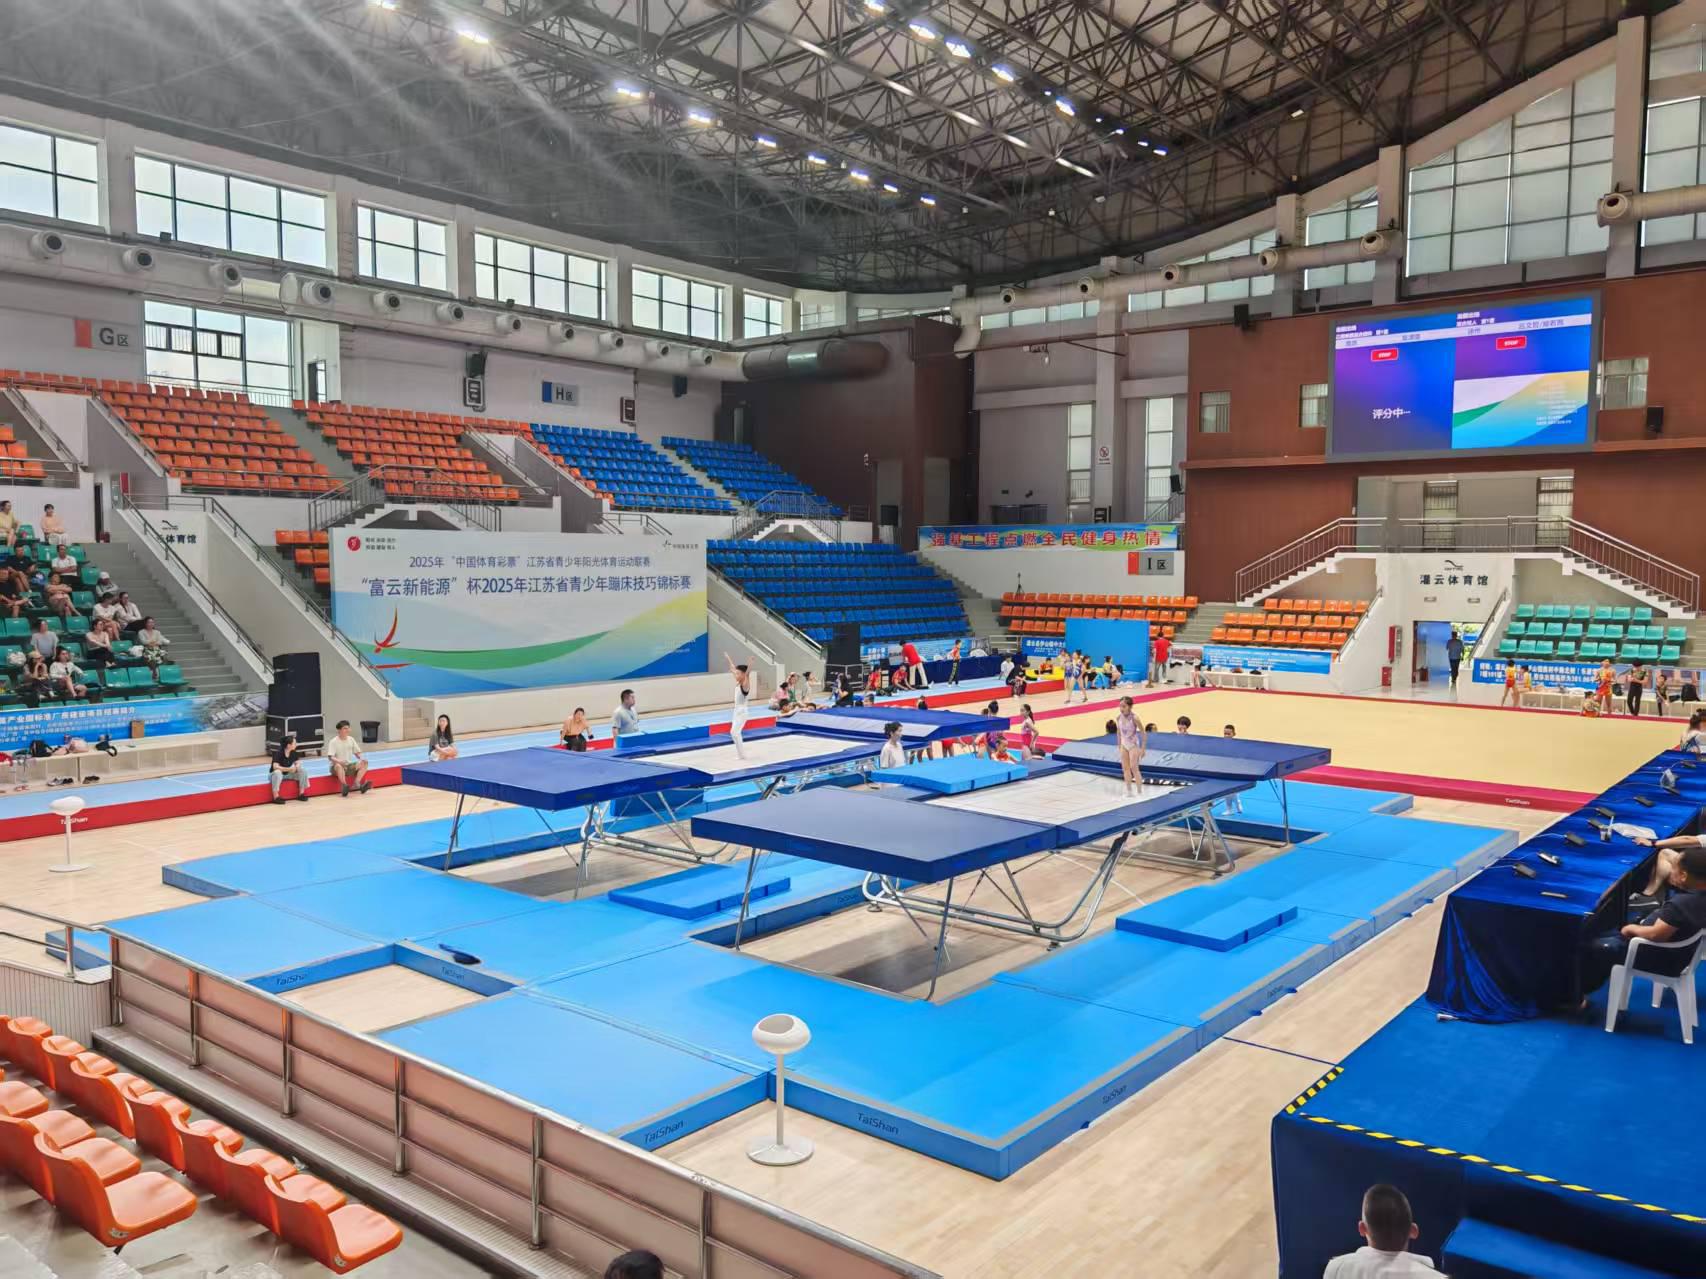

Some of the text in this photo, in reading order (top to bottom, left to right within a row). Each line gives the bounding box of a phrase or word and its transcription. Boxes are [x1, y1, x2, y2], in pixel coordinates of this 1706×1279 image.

[556, 387, 573, 401] H区
[931, 530, 1161, 547] 强基工程点燃全民健身热情
[1420, 574, 1488, 586] 灌云体育馆
[644, 1120, 684, 1143] TaiShan
[857, 1112, 899, 1135] TaiShan
